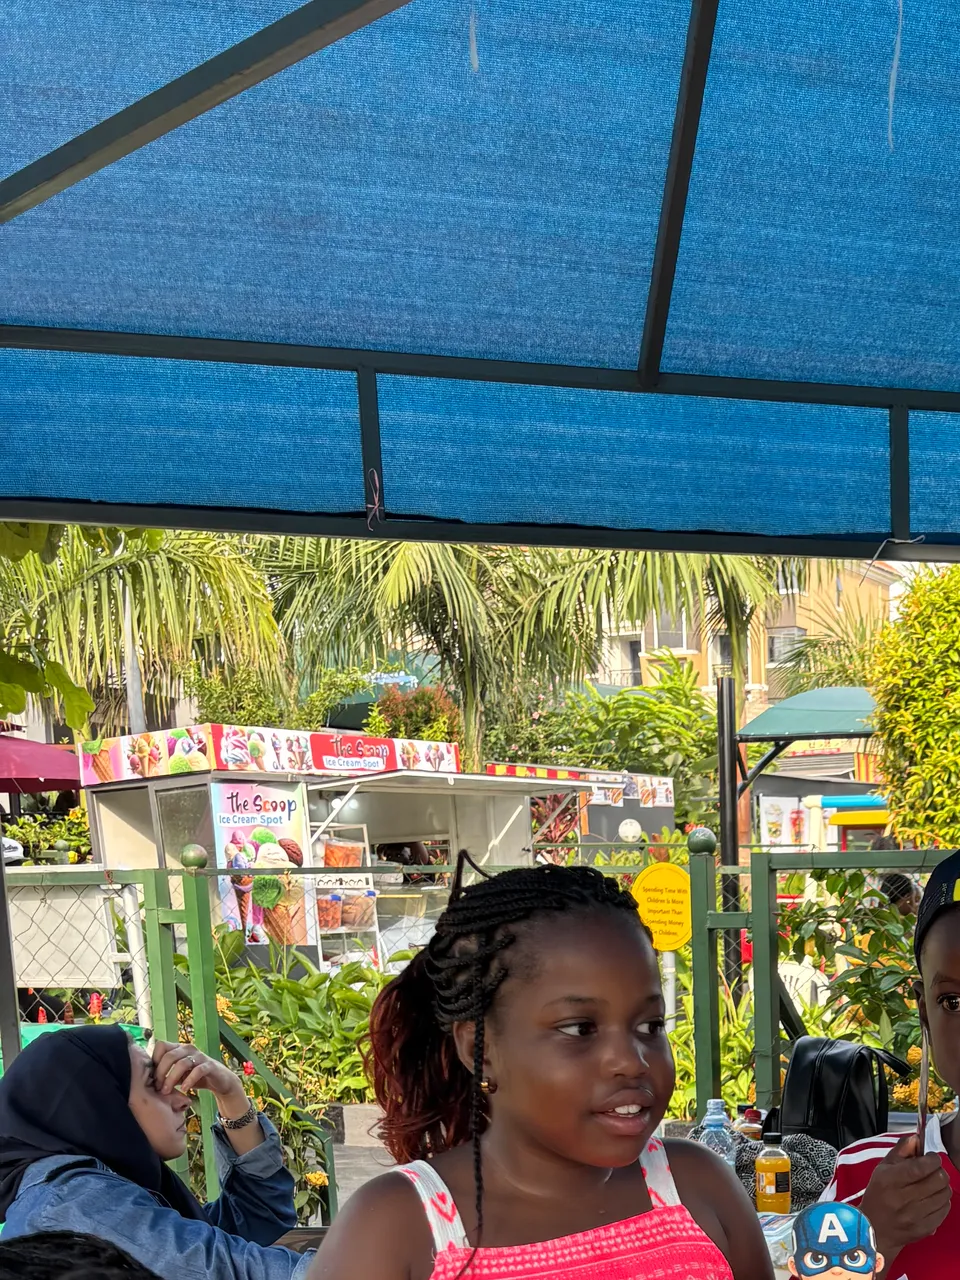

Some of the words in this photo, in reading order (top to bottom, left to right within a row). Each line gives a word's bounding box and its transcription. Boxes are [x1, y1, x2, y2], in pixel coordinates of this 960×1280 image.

[330, 737, 353, 757] the
[325, 758, 337, 766] Ice
[337, 758, 362, 767] Cream
[363, 759, 380, 768] Spot
[227, 791, 249, 813] the
[253, 794, 297, 821] Scoop
[219, 815, 231, 824] Ice
[232, 814, 258, 824] Cream
[260, 814, 283, 827] Spot
[817, 1212, 849, 1243] A
